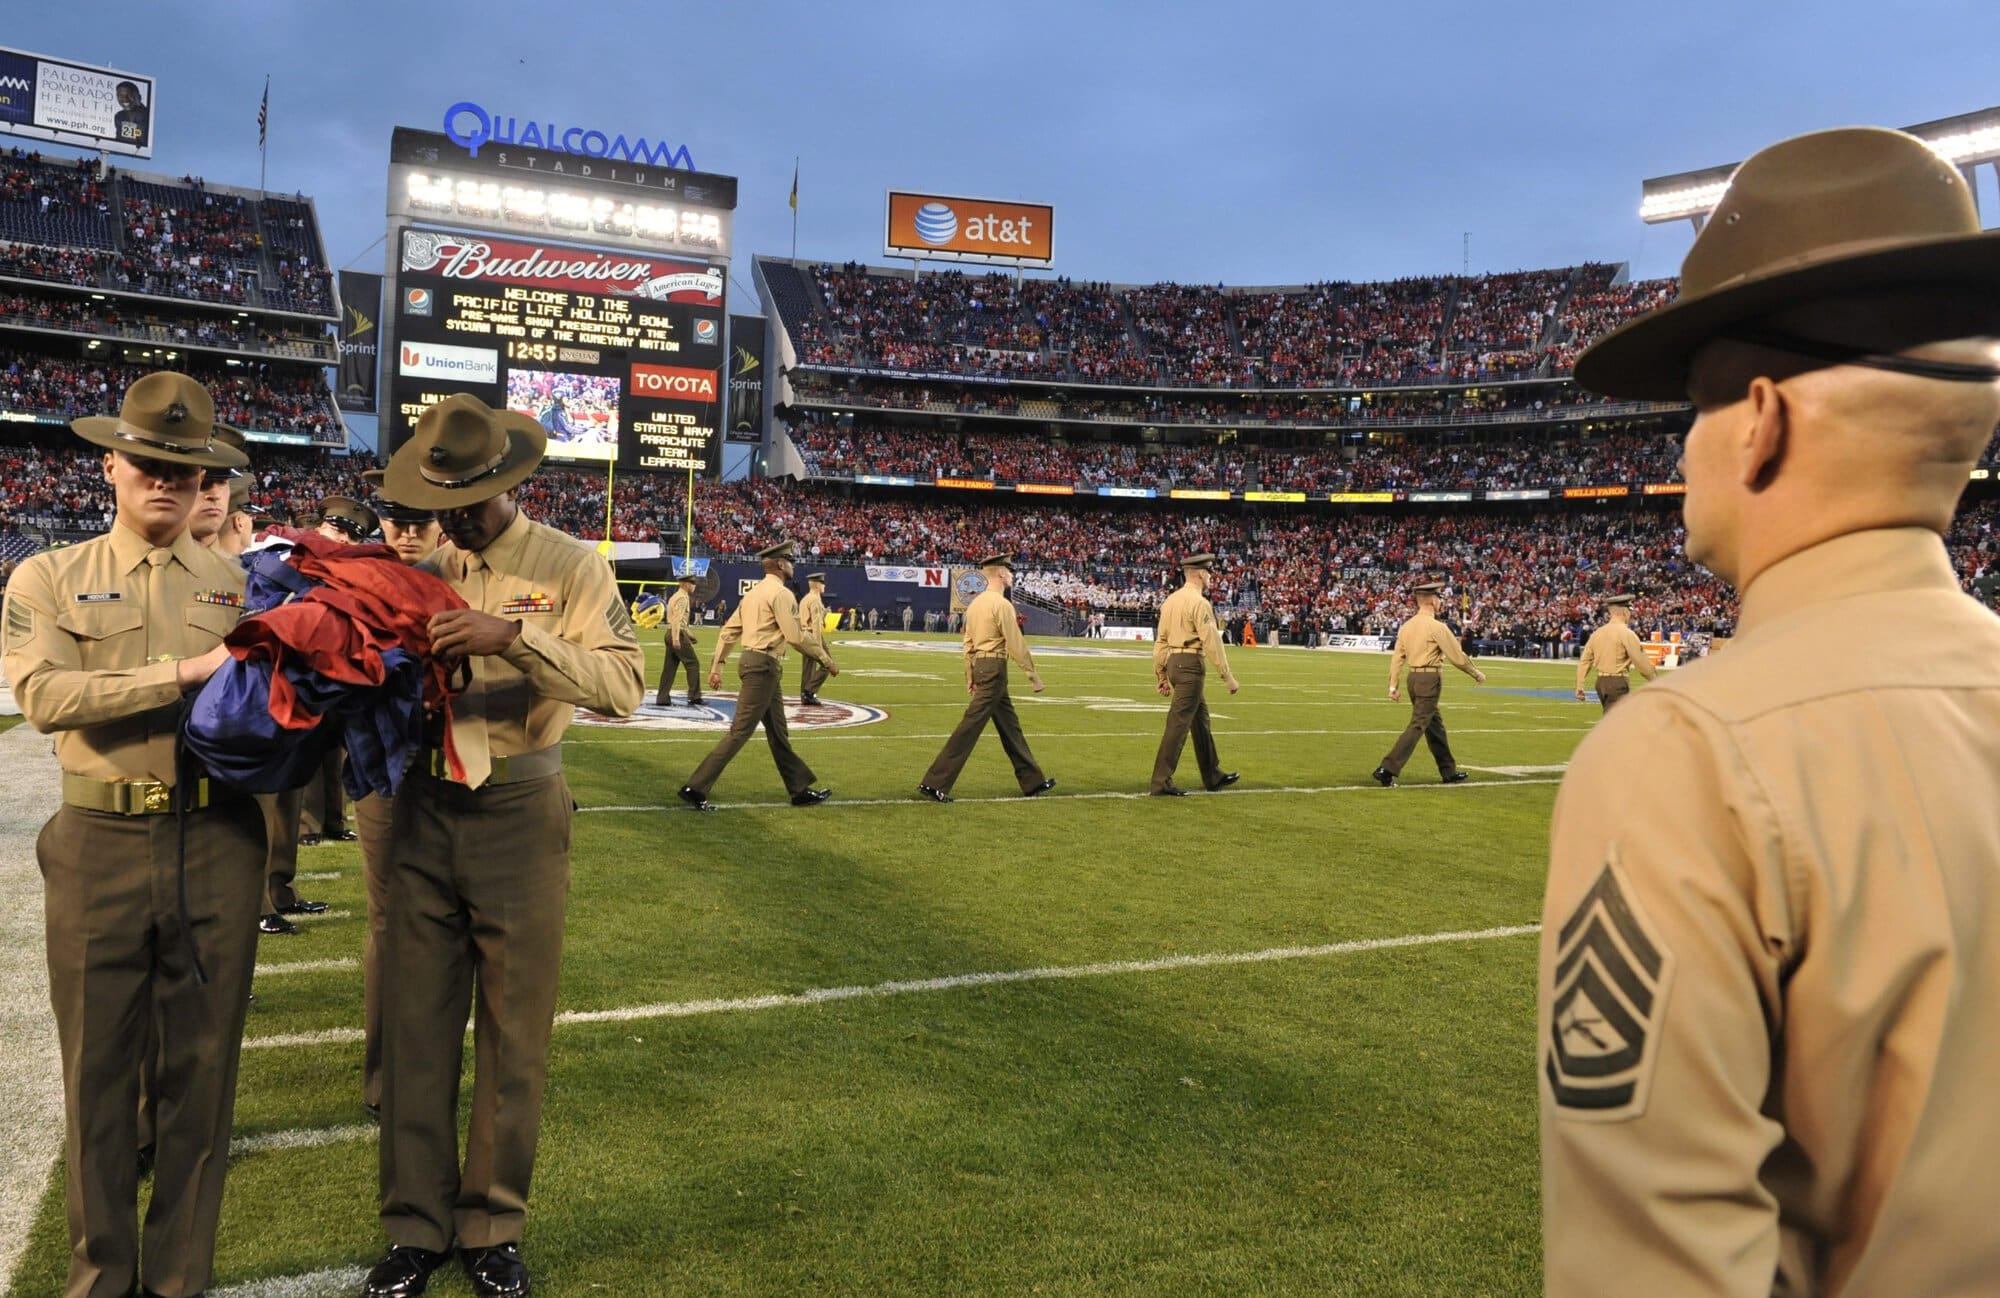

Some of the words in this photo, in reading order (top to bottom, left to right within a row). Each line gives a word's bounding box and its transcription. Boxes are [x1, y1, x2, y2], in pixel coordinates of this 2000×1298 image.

[42, 68, 114, 90] PALOMAR
[42, 80, 114, 102] POMERADO
[41, 92, 113, 114] HEALTH
[46, 116, 106, 134] www.pph.org
[444, 102, 696, 172] QUALCOMM
[498, 152, 676, 188] STADIUM
[964, 213, 1032, 245] at&t
[433, 244, 650, 282] Budweiser
[653, 278, 693, 294] American
[694, 278, 720, 291] Lager
[504, 288, 568, 305] WELCOME
[576, 295, 595, 308] TO
[602, 298, 629, 312] THE
[453, 294, 519, 312] PACIFIC
[526, 302, 563, 318] LIFE
[570, 307, 632, 324] HOLIDAY
[639, 314, 674, 328] BOWL
[461, 309, 520, 324] PRE-GAME
[525, 316, 554, 328] SHOW
[560, 320, 621, 335] PRESENTED
[626, 326, 641, 336] BY
[646, 328, 667, 340] THE
[446, 318, 491, 334] SYCUAN
[496, 324, 526, 337] BAND
[531, 328, 547, 338] OF
[552, 330, 574, 342] THE
[640, 339, 680, 353] NATION
[339, 340, 376, 356] Sprint
[508, 342, 557, 362] 12:55
[560, 350, 599, 362] SYCUAN
[426, 356, 496, 373] UnionBank
[636, 373, 712, 394] TOYOTA
[730, 378, 762, 392] Sprint
[651, 412, 696, 425] UNITED
[634, 422, 678, 435] STATES
[684, 427, 714, 438] NAVY
[640, 434, 706, 448] PARACHUTE
[658, 446, 688, 458] TEAM
[640, 456, 706, 470] LEAPFROGS
[938, 480, 964, 488] WELLS
[965, 480, 992, 488] FARGO
[1566, 488, 1596, 496] WELLS
[1597, 487, 1628, 496] FARGO
[925, 569, 942, 586] N
